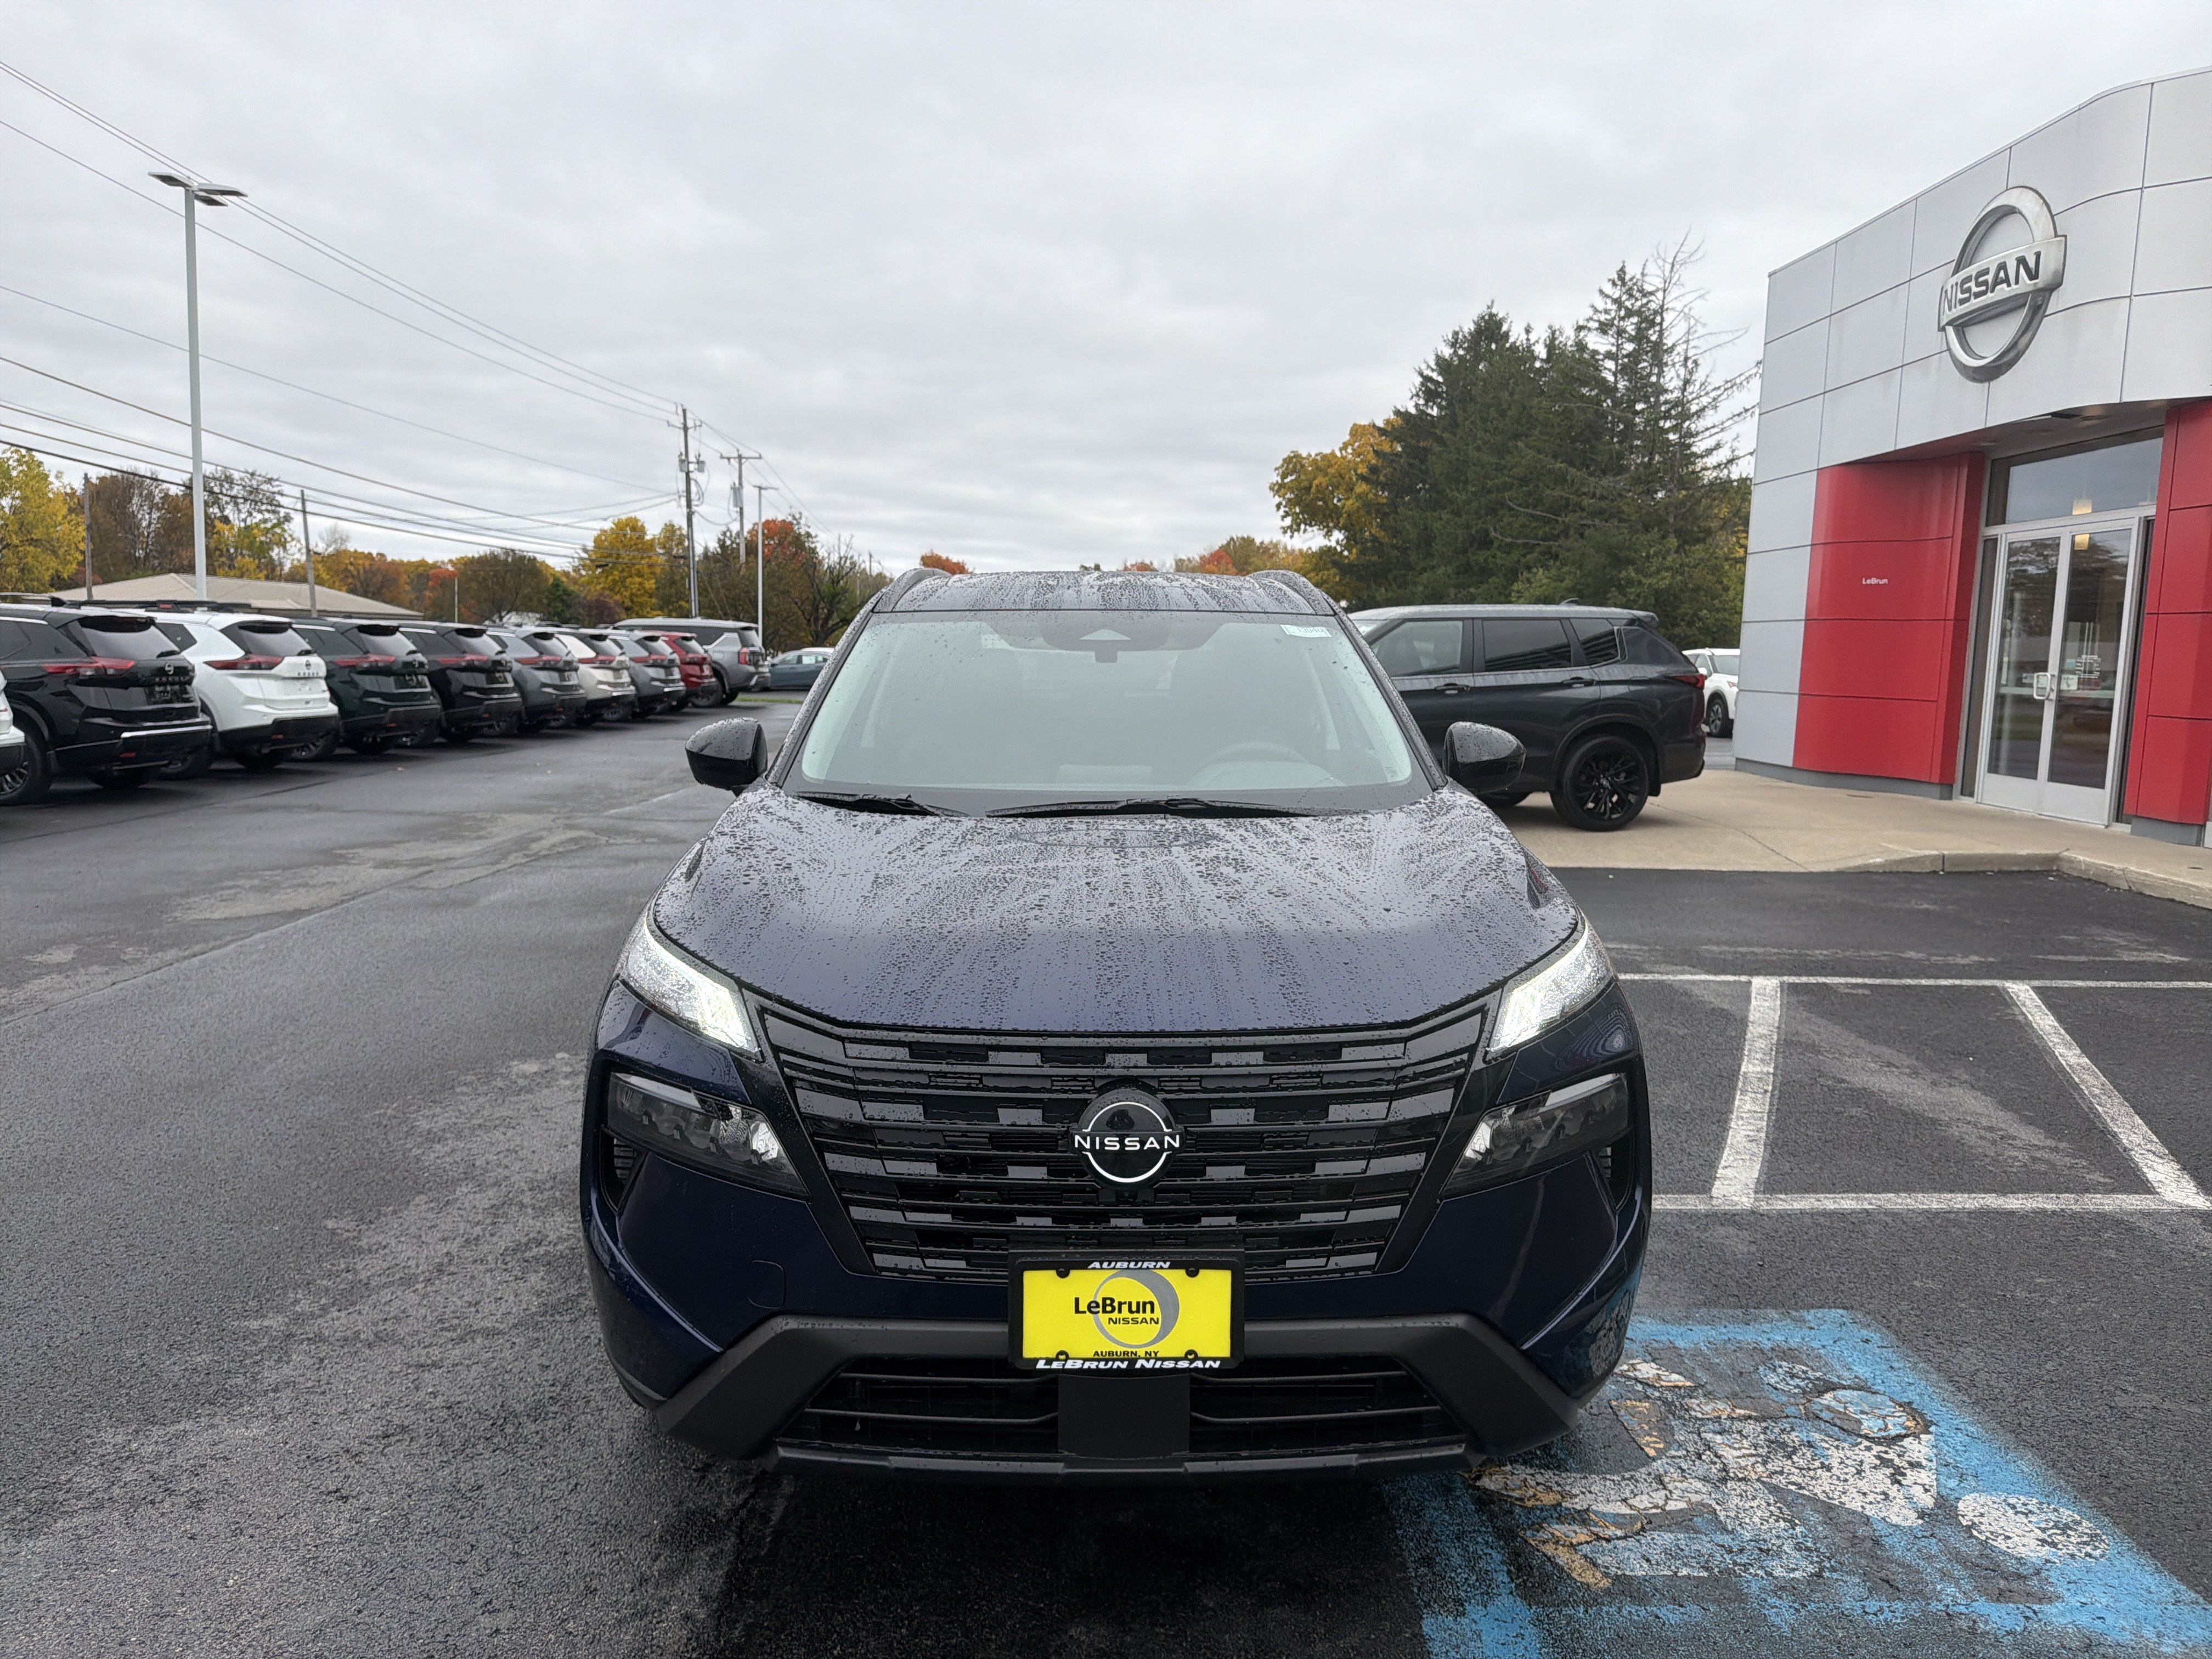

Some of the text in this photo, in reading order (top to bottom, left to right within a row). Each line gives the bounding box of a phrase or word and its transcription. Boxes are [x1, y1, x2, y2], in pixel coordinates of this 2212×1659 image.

[1943, 250, 2041, 316] NISSAN
[1075, 1135, 1180, 1150] NISSAN
[1074, 1296, 1155, 1314] LeBrun
[1135, 1359, 1221, 1369] NISSAN
